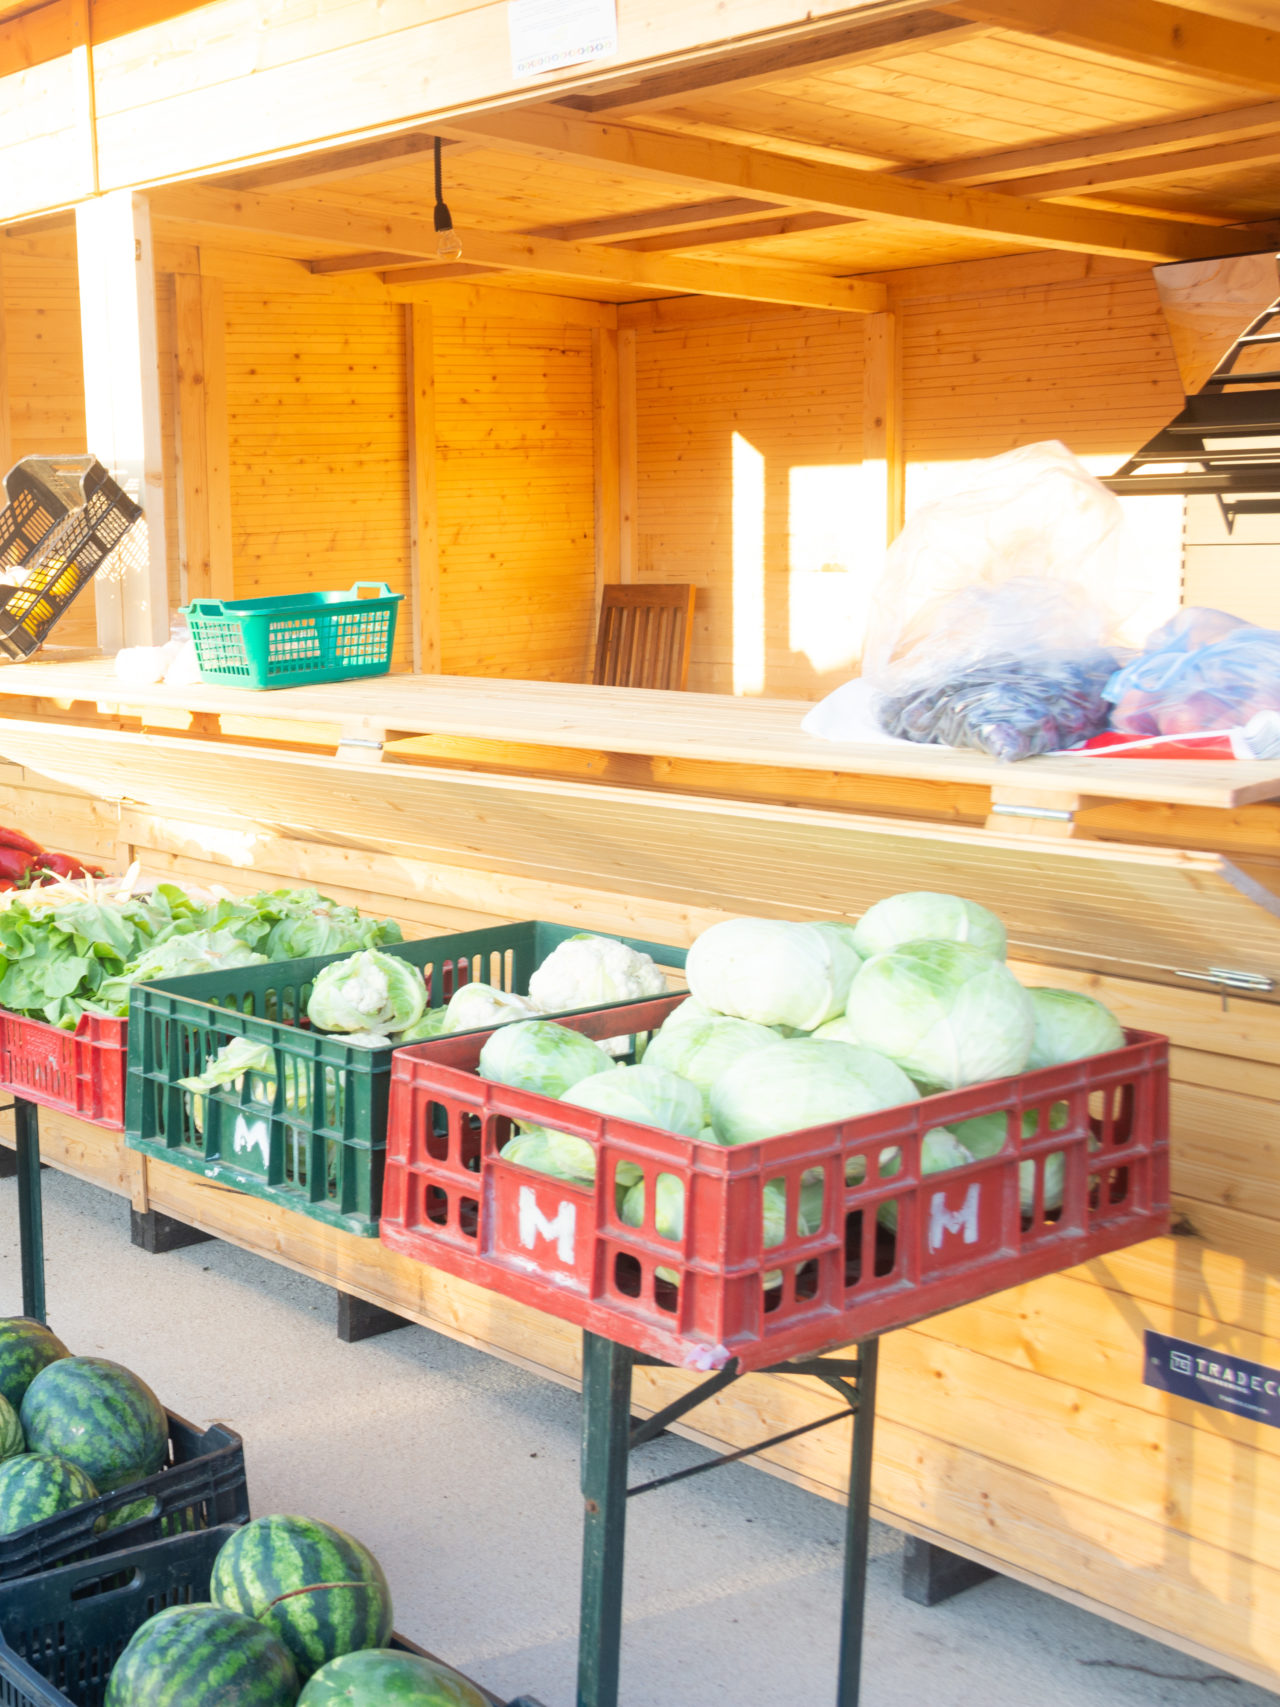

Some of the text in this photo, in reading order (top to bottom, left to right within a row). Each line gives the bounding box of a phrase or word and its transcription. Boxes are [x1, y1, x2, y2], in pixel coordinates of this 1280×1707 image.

[233, 1112, 270, 1169] M
[518, 1185, 576, 1265] M
[928, 1182, 982, 1254] M
[1195, 1357, 1280, 1396] TRADEC
